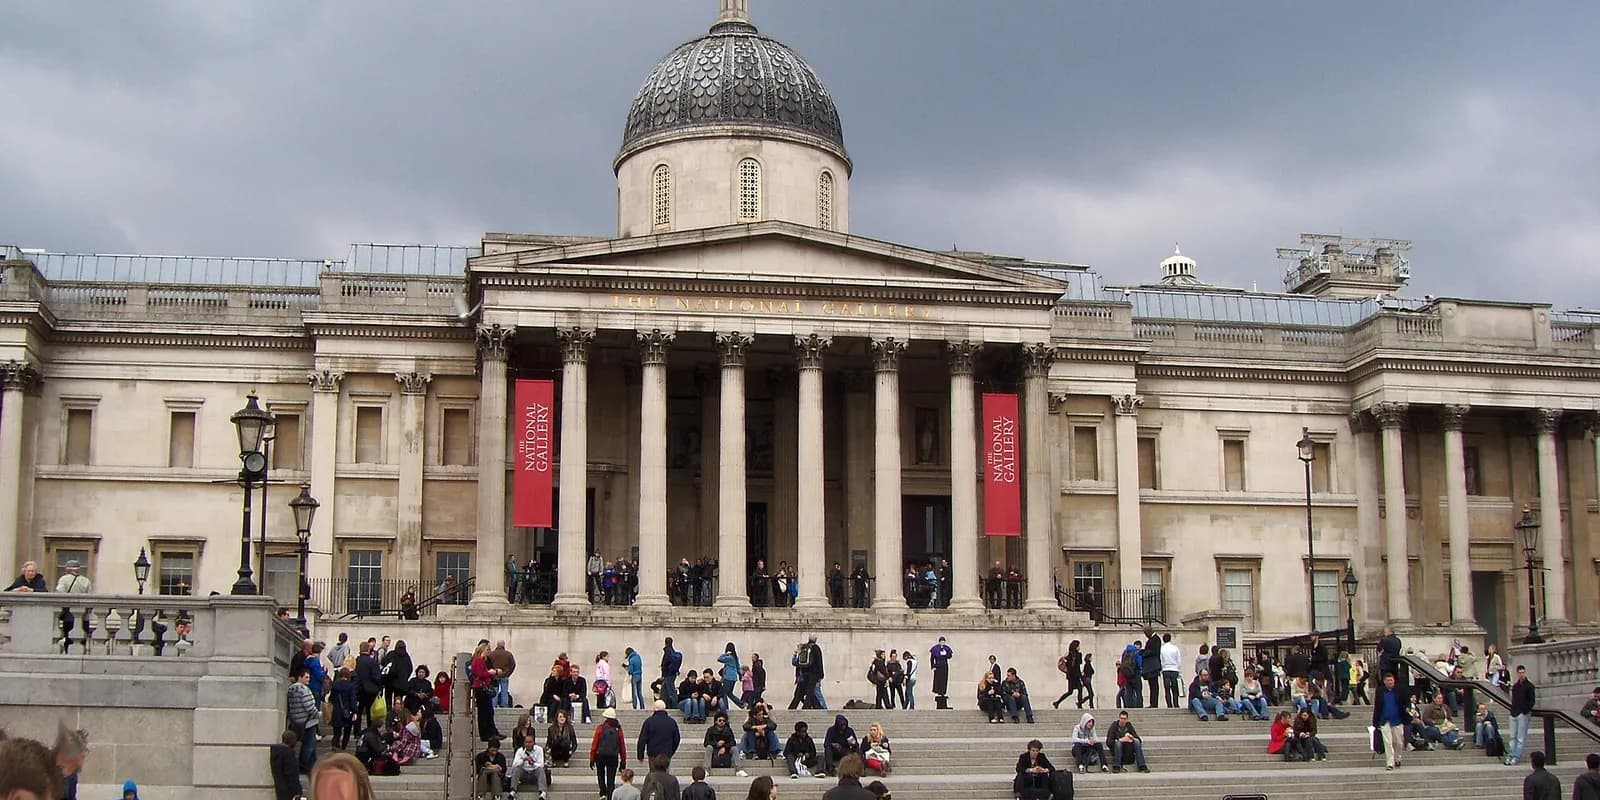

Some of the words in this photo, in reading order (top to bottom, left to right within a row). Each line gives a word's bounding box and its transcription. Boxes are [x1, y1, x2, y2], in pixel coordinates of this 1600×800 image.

[611, 294, 658, 308] THE
[675, 296, 803, 313] NATIONAL
[822, 303, 930, 319] GALLERY
[525, 403, 536, 471] NATIONAL
[536, 404, 549, 472] GALLERY
[993, 416, 1003, 481] NATIONAL
[1003, 417, 1015, 482] GALLERY
